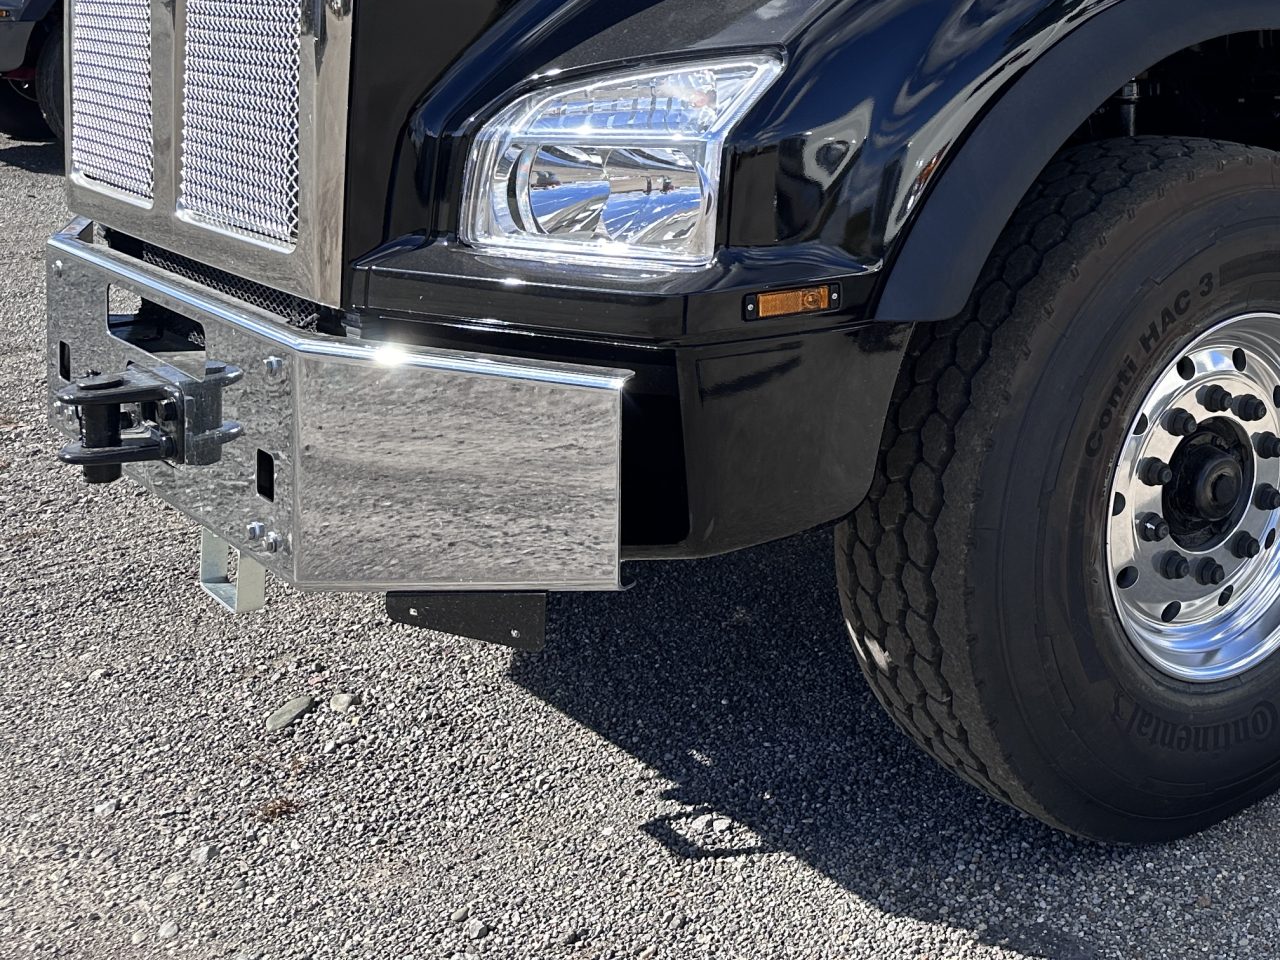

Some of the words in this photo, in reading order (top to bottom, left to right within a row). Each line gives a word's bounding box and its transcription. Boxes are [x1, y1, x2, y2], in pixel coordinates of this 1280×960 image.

[1085, 354, 1139, 458] Conti
[1138, 290, 1192, 355] HAC
[1199, 272, 1214, 298] 3
[1127, 700, 1279, 752] Continental
